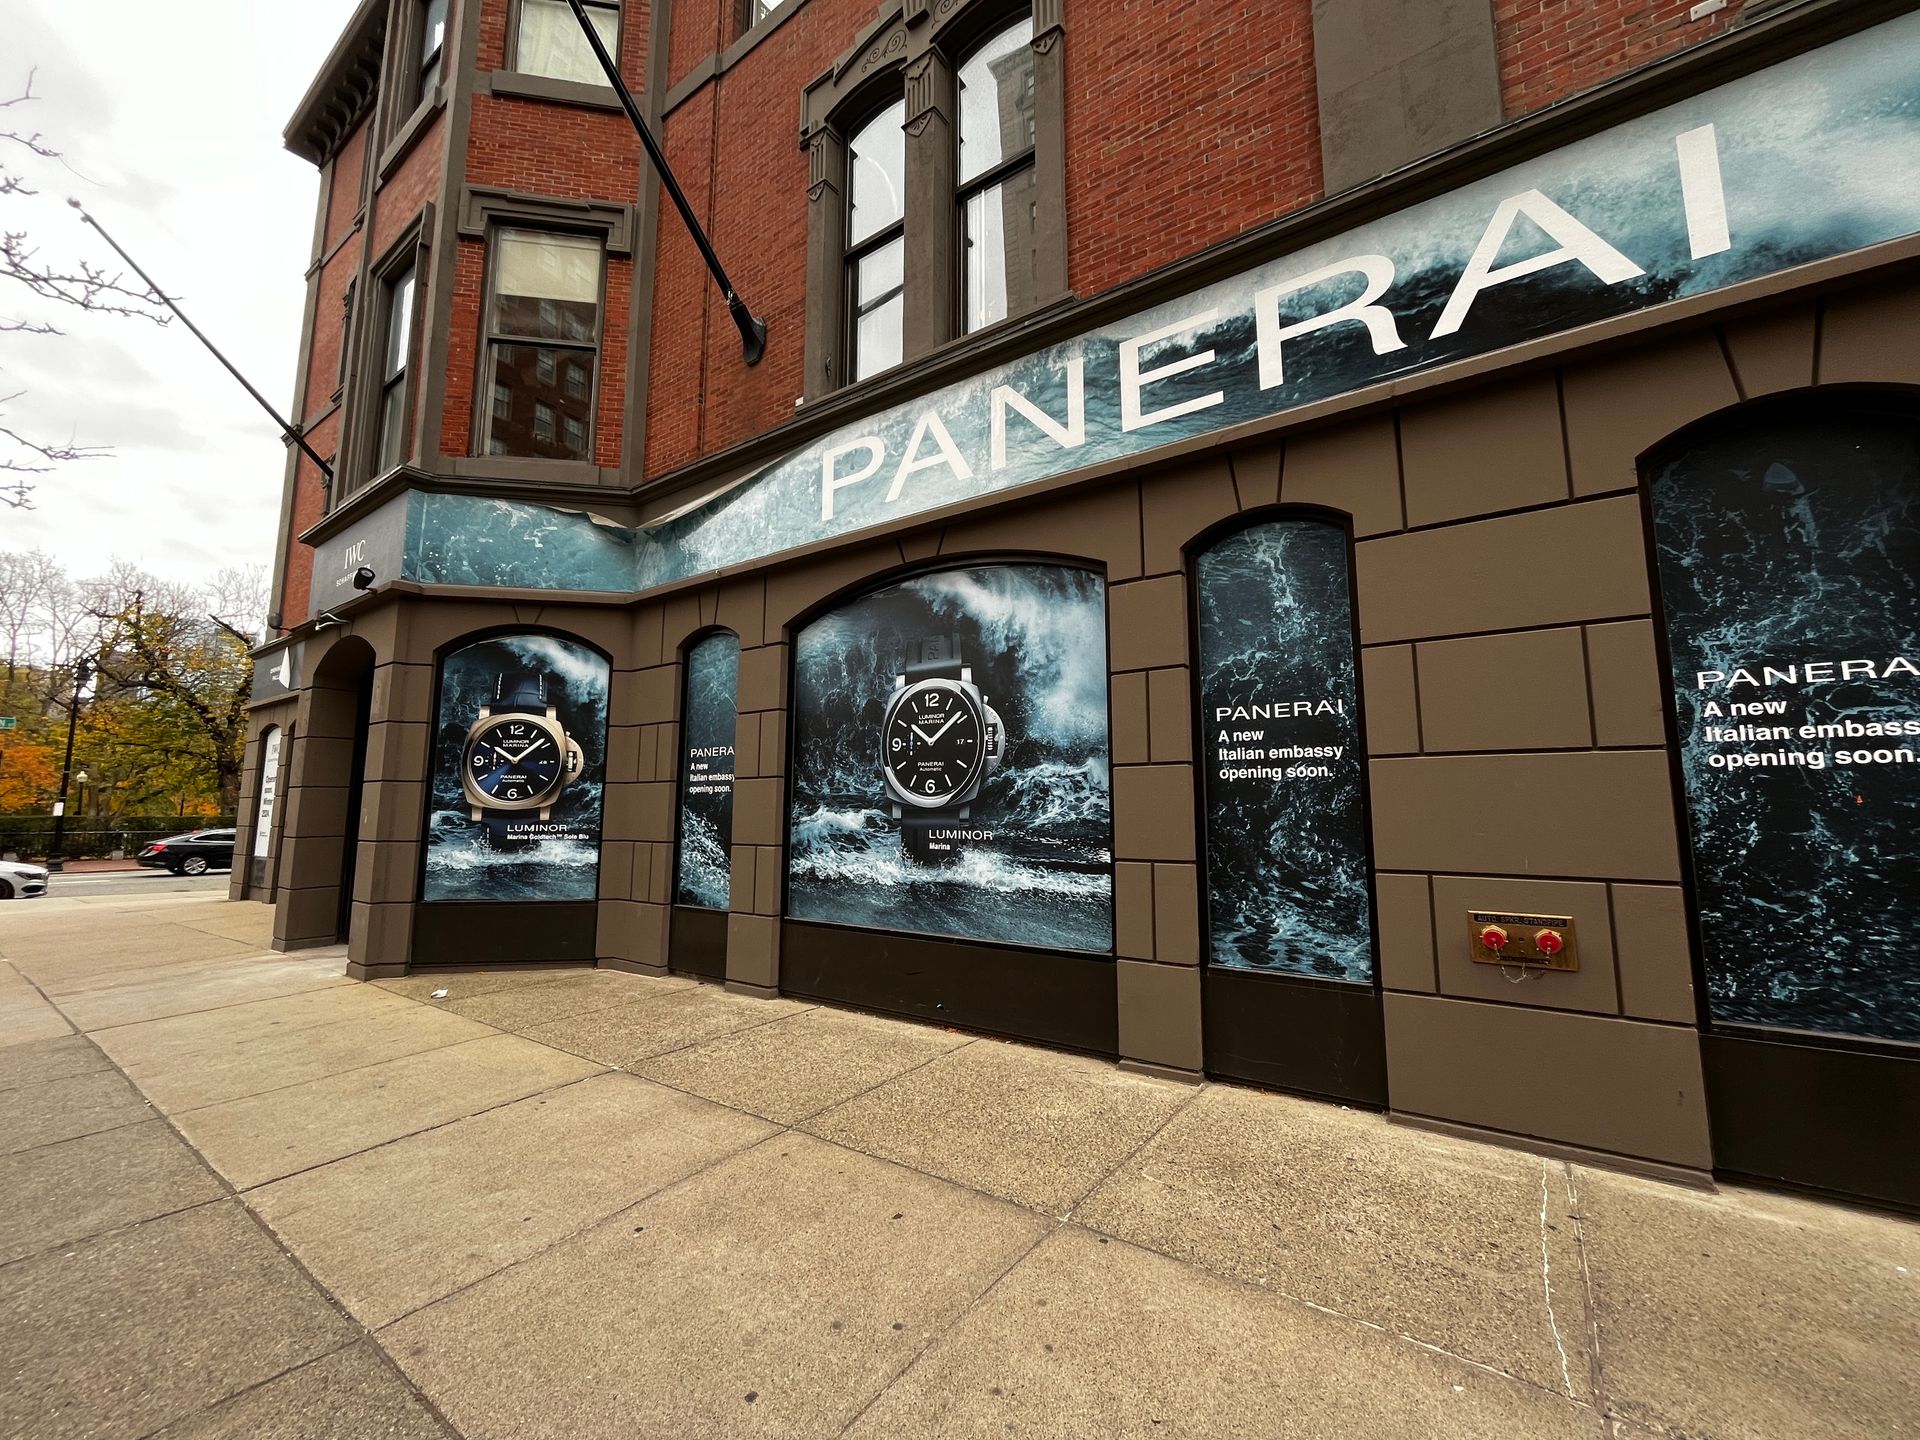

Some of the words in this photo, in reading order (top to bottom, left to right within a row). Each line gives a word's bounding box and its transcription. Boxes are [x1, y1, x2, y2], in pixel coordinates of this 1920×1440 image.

[820, 123, 1732, 521] PANERAI
[344, 540, 366, 569] IWC
[1696, 656, 1920, 690] PANERA
[925, 693, 940, 707] 12
[1215, 698, 1344, 722] PANERAI
[1703, 701, 1723, 718] A
[1730, 700, 1788, 717] new
[510, 724, 525, 735] 12
[1217, 729, 1230, 743] A
[1232, 730, 1265, 742] new
[1704, 724, 1791, 743] Italian
[1798, 719, 1920, 739] embass
[690, 745, 735, 758] PANERA
[891, 737, 902, 752] 9
[1218, 747, 1265, 761] Italian
[1268, 745, 1344, 760] embassy
[1708, 748, 1826, 771] opening
[1834, 748, 1920, 765] soon.
[473, 755, 484, 767] 9
[690, 762, 696, 771] A
[690, 773, 708, 782] Italian
[1219, 765, 1282, 782] opening
[1285, 766, 1334, 778] soon.
[689, 784, 713, 795] opening
[714, 785, 732, 793] soon.
[924, 779, 936, 793] 6
[507, 788, 518, 799] 6
[507, 824, 568, 832] LUMINOR
[928, 829, 993, 841] LUMINOR
[928, 842, 951, 850] Marina
